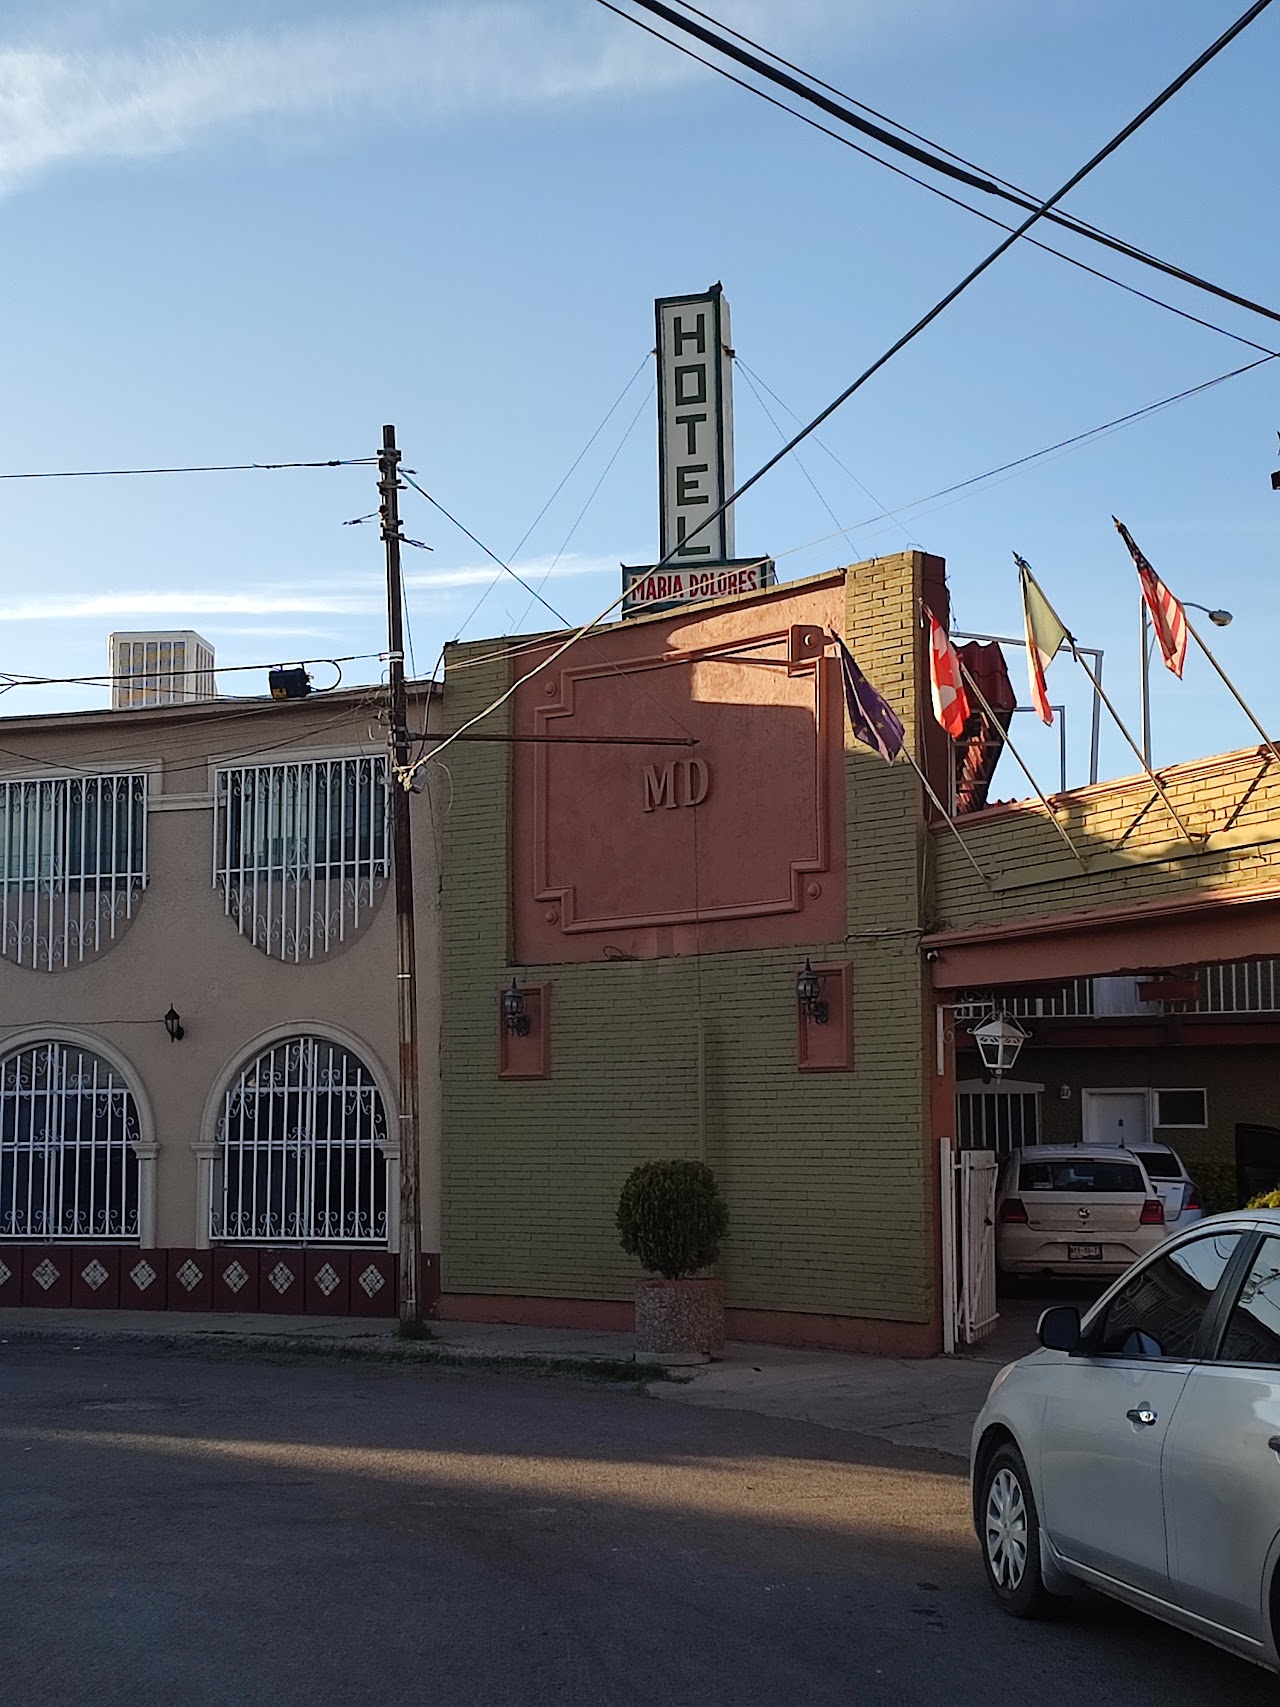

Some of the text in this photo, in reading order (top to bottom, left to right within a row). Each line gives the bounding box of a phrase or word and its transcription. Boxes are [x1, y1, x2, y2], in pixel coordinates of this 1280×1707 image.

[673, 314, 710, 556] HOTEL
[631, 570, 757, 601] MARIA DOLORES
[642, 758, 709, 812] MD
